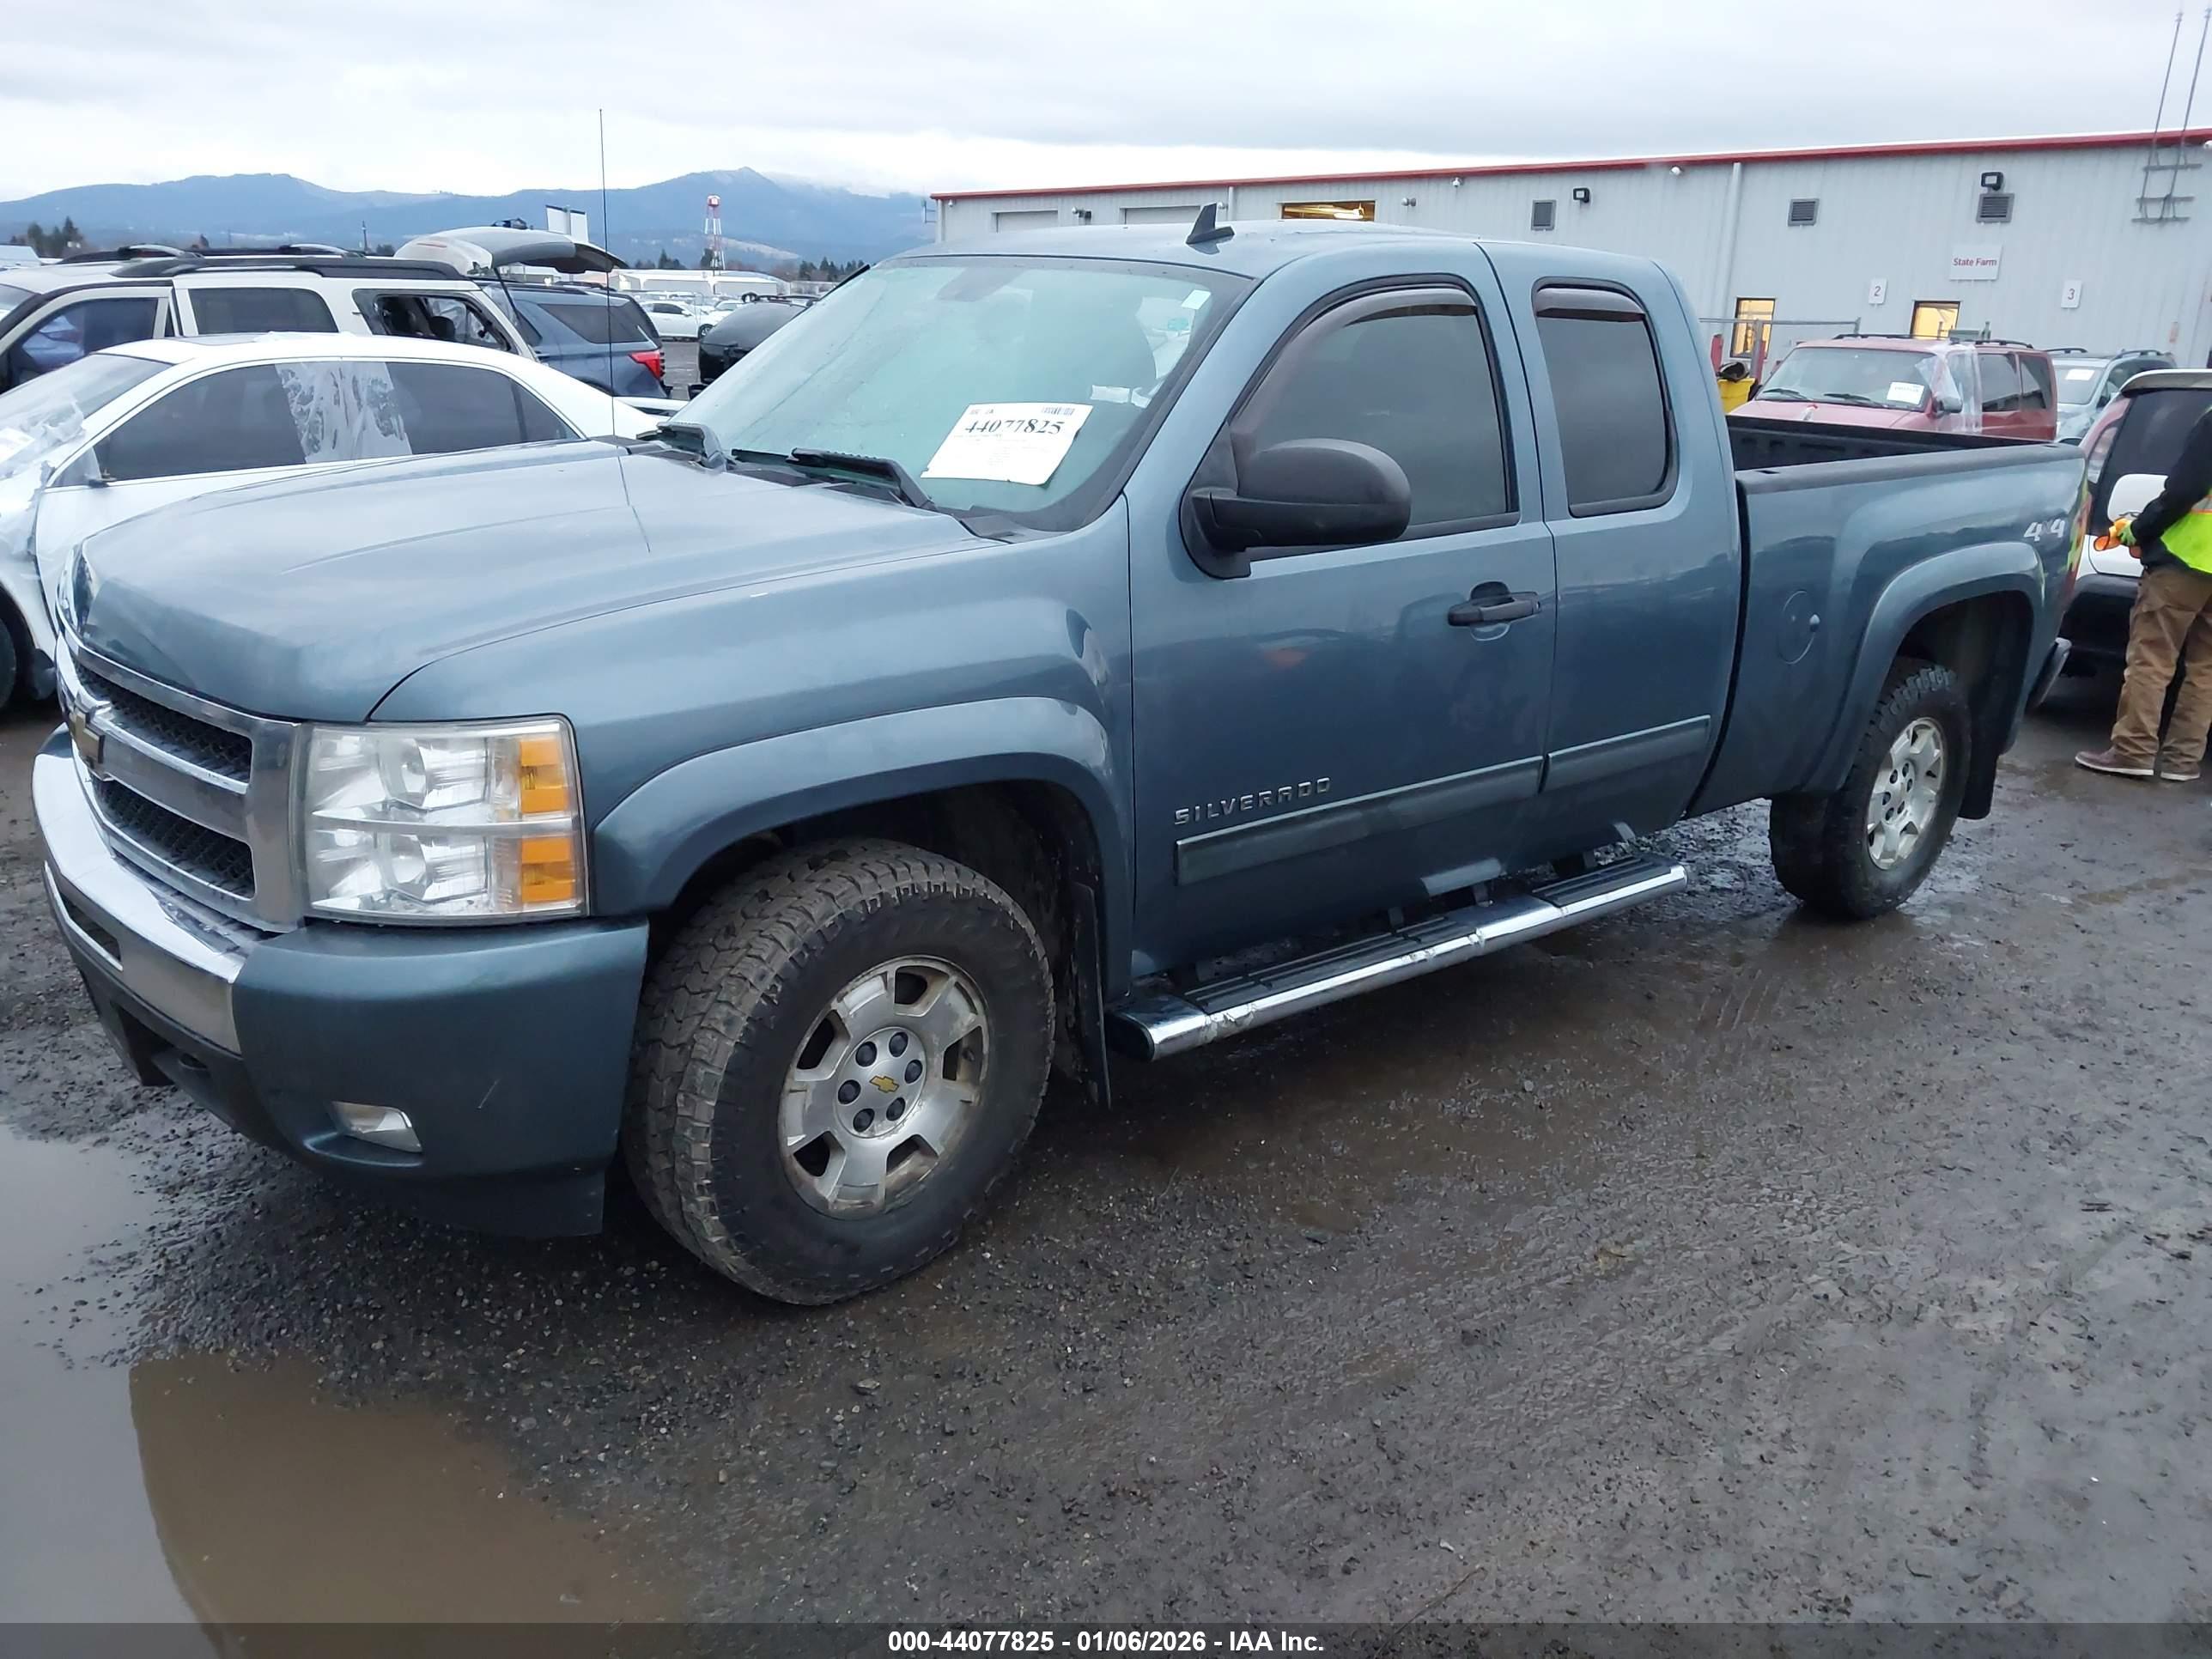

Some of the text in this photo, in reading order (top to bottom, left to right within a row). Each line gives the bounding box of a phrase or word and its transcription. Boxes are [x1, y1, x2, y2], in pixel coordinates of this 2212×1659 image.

[1953, 258, 1997, 266] State Farm
[1874, 285, 1881, 297] 2
[2067, 288, 2075, 301] 3
[964, 418, 1066, 434] 44077825
[1174, 777, 1330, 825] SILVERADO
